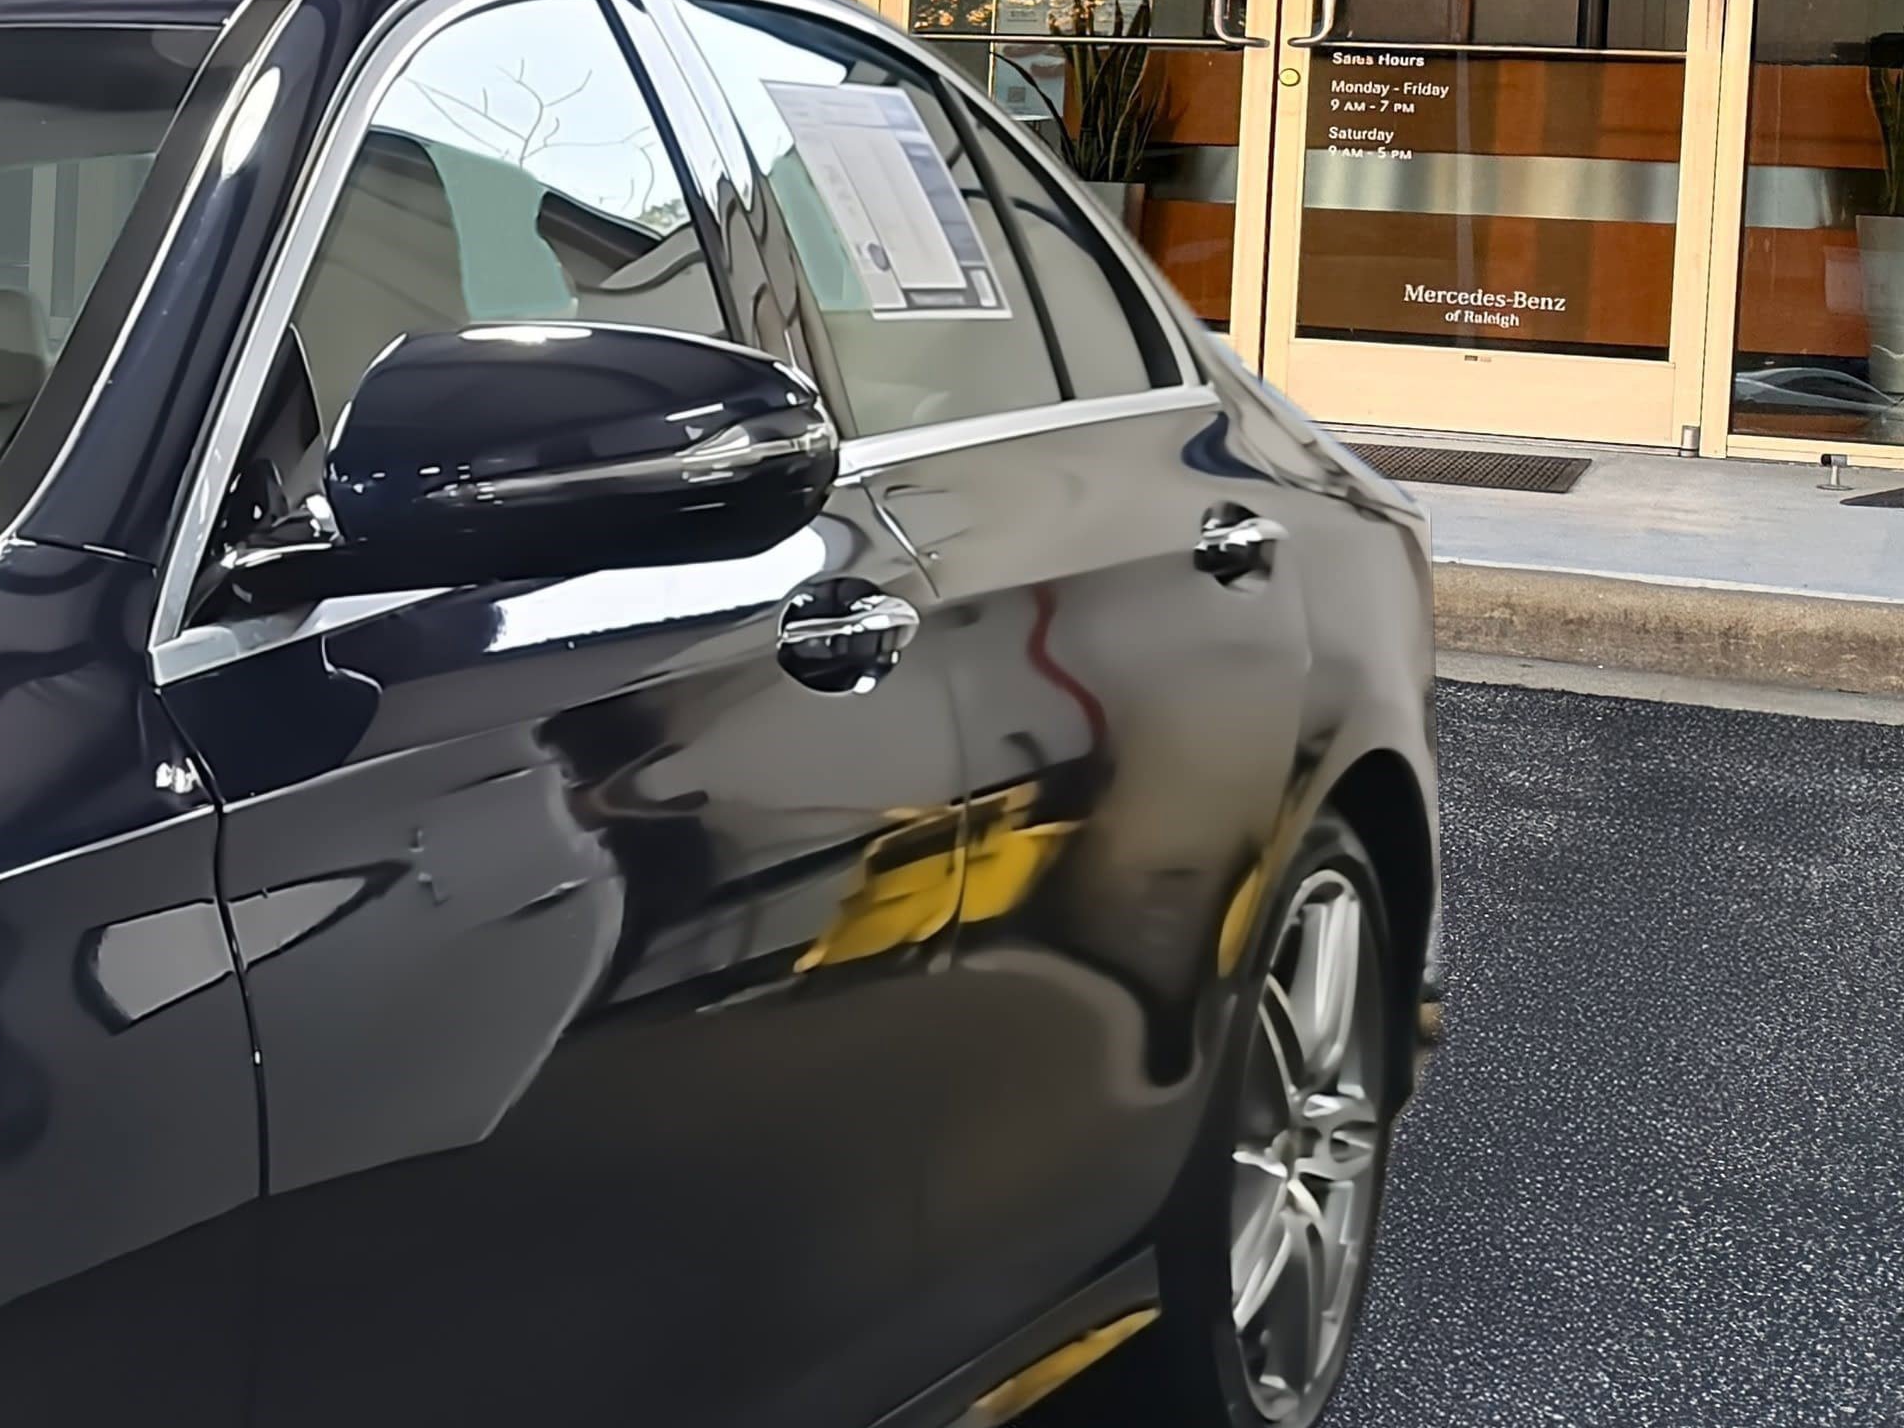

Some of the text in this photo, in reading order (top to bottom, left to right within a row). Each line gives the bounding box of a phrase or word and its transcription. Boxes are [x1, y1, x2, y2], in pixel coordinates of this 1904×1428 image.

[1378, 53, 1425, 67] Hours
[1331, 80, 1390, 97] Monday
[1403, 82, 1449, 98] Friday
[1330, 99, 1340, 111] 9
[1344, 102, 1366, 111] AM
[1380, 100, 1389, 112] 7
[1393, 103, 1415, 113] PM
[1328, 126, 1394, 143] Saturday
[1328, 145, 1337, 157] 9
[1341, 148, 1363, 158] AM
[1378, 147, 1386, 159] 5
[1391, 150, 1412, 160] PM
[1403, 284, 1566, 311] Mercedes-Benz
[1445, 309, 1520, 328] of Raleigh
